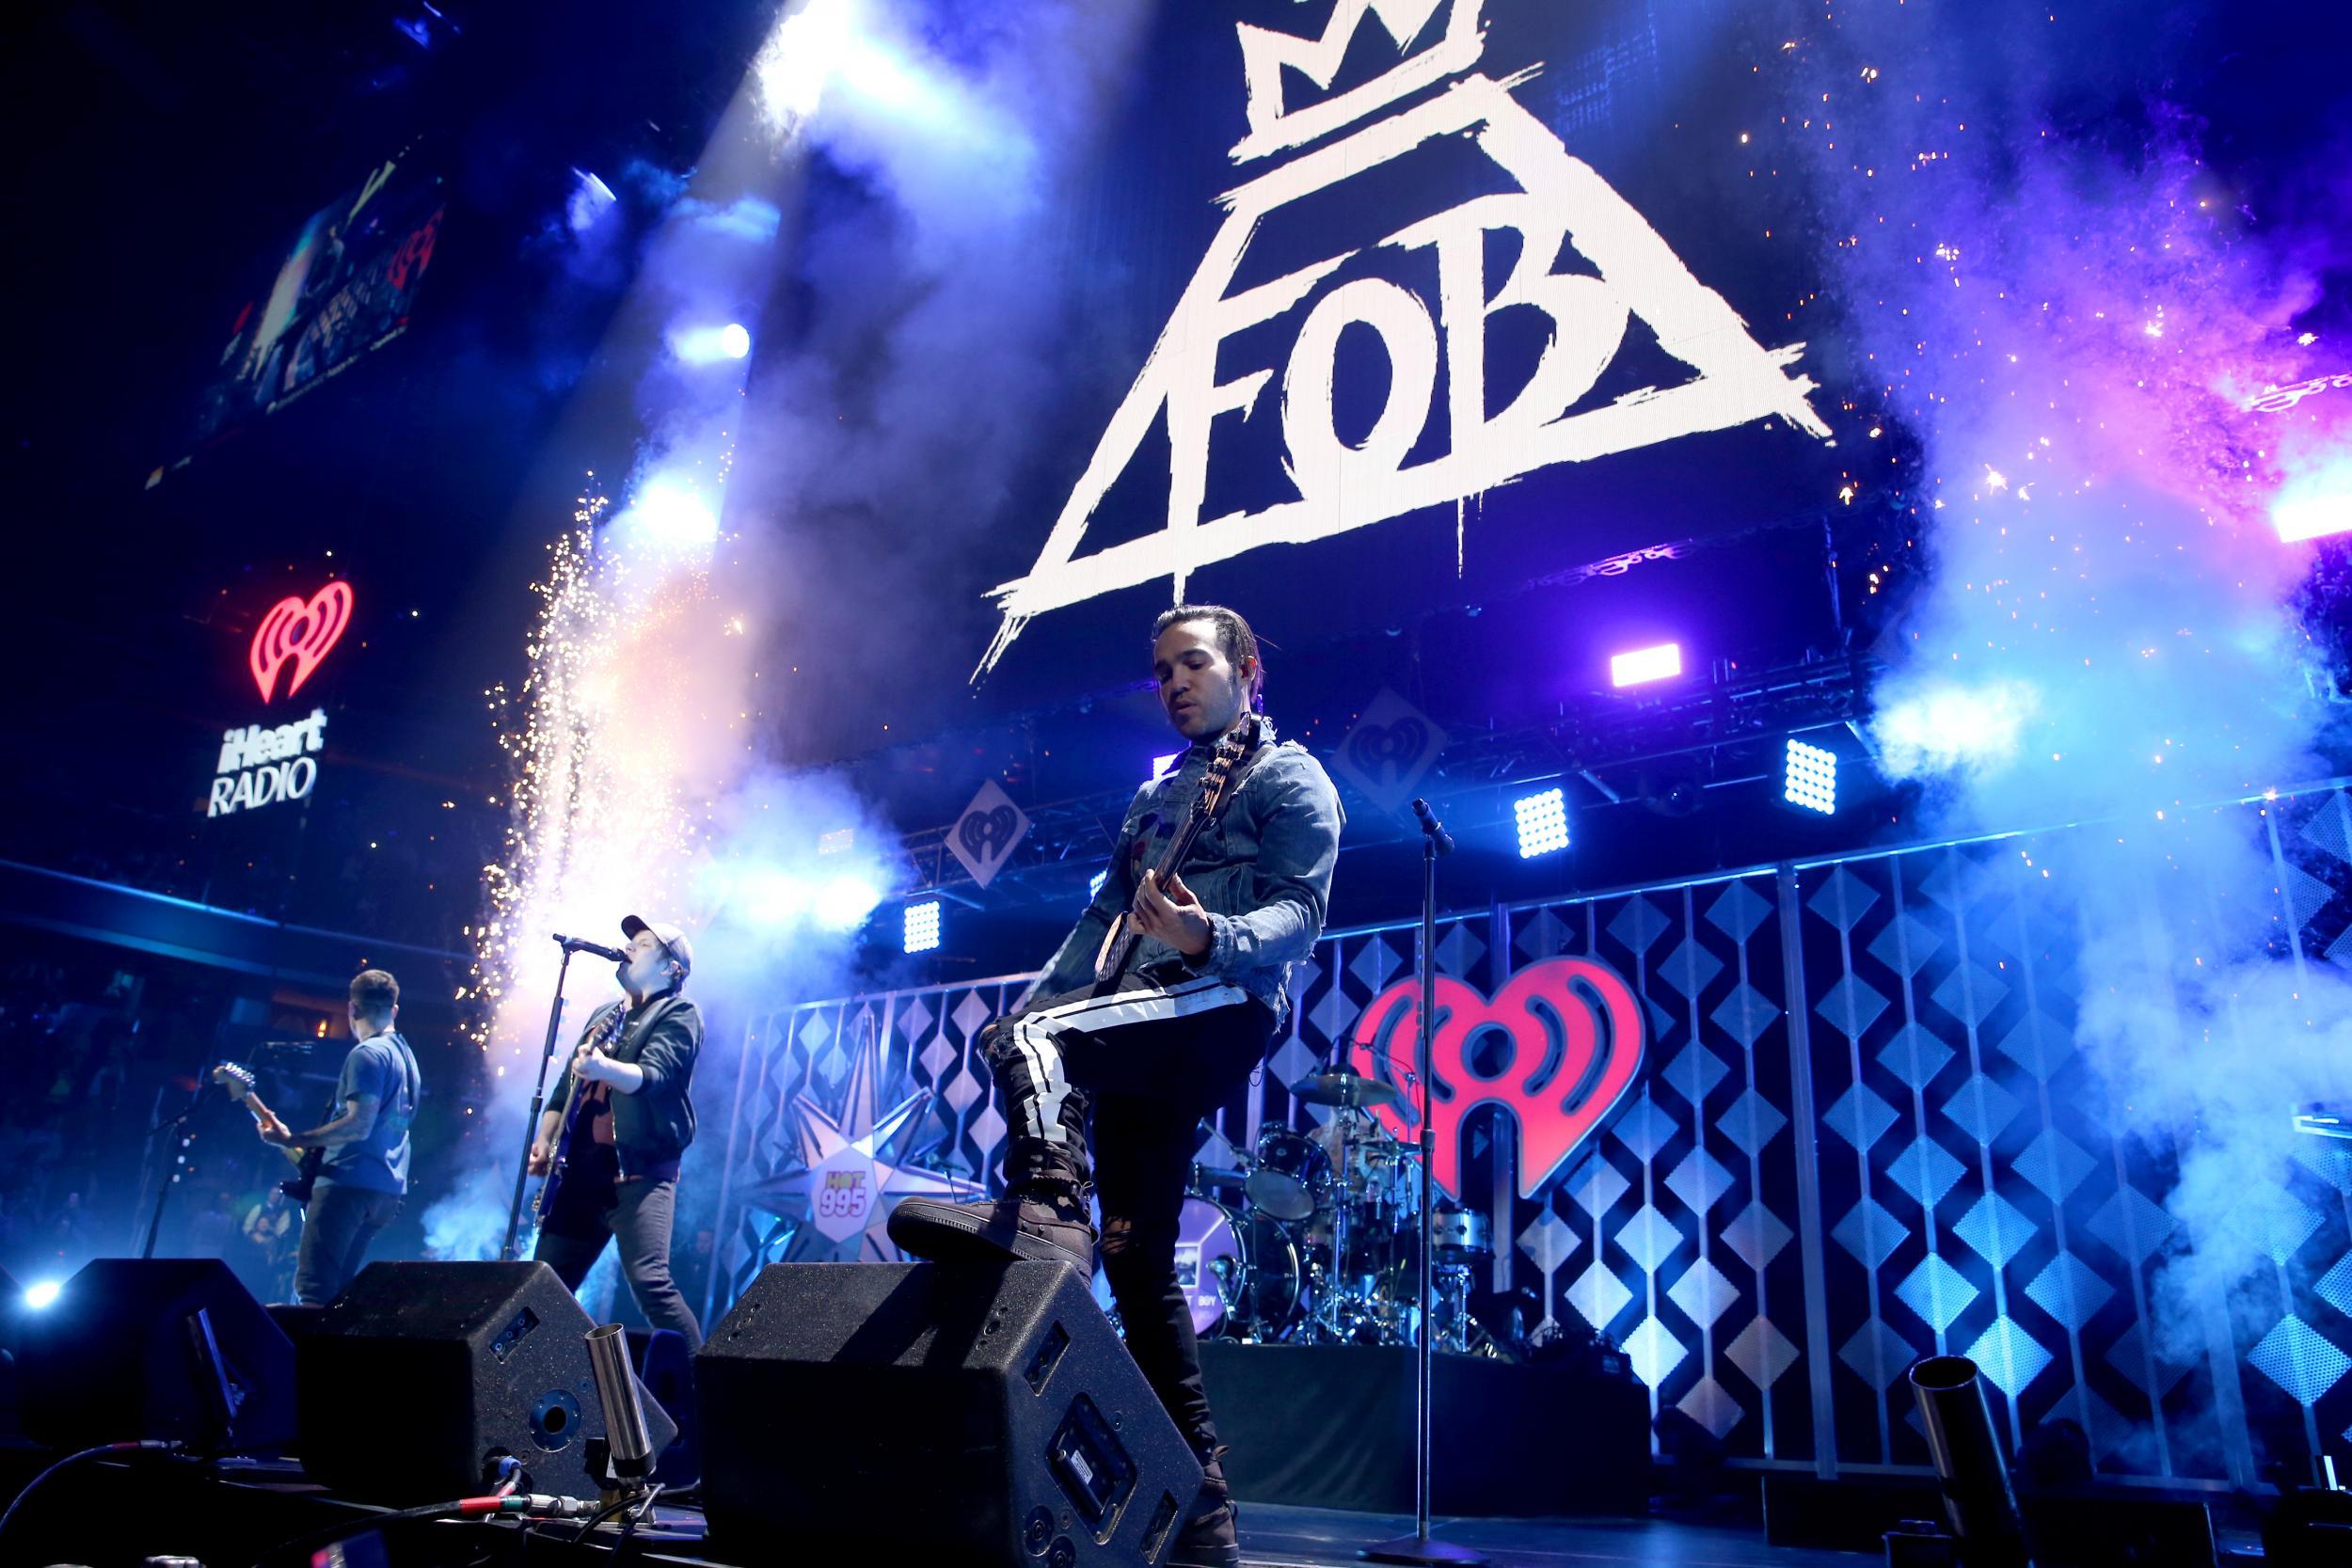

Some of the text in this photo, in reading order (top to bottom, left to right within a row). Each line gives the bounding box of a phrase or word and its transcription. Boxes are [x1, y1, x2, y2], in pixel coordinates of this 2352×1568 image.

[1165, 191, 1632, 532] FOB
[216, 707, 327, 773] iHeart
[207, 756, 317, 817] RADIO
[825, 1170, 866, 1190] HOT
